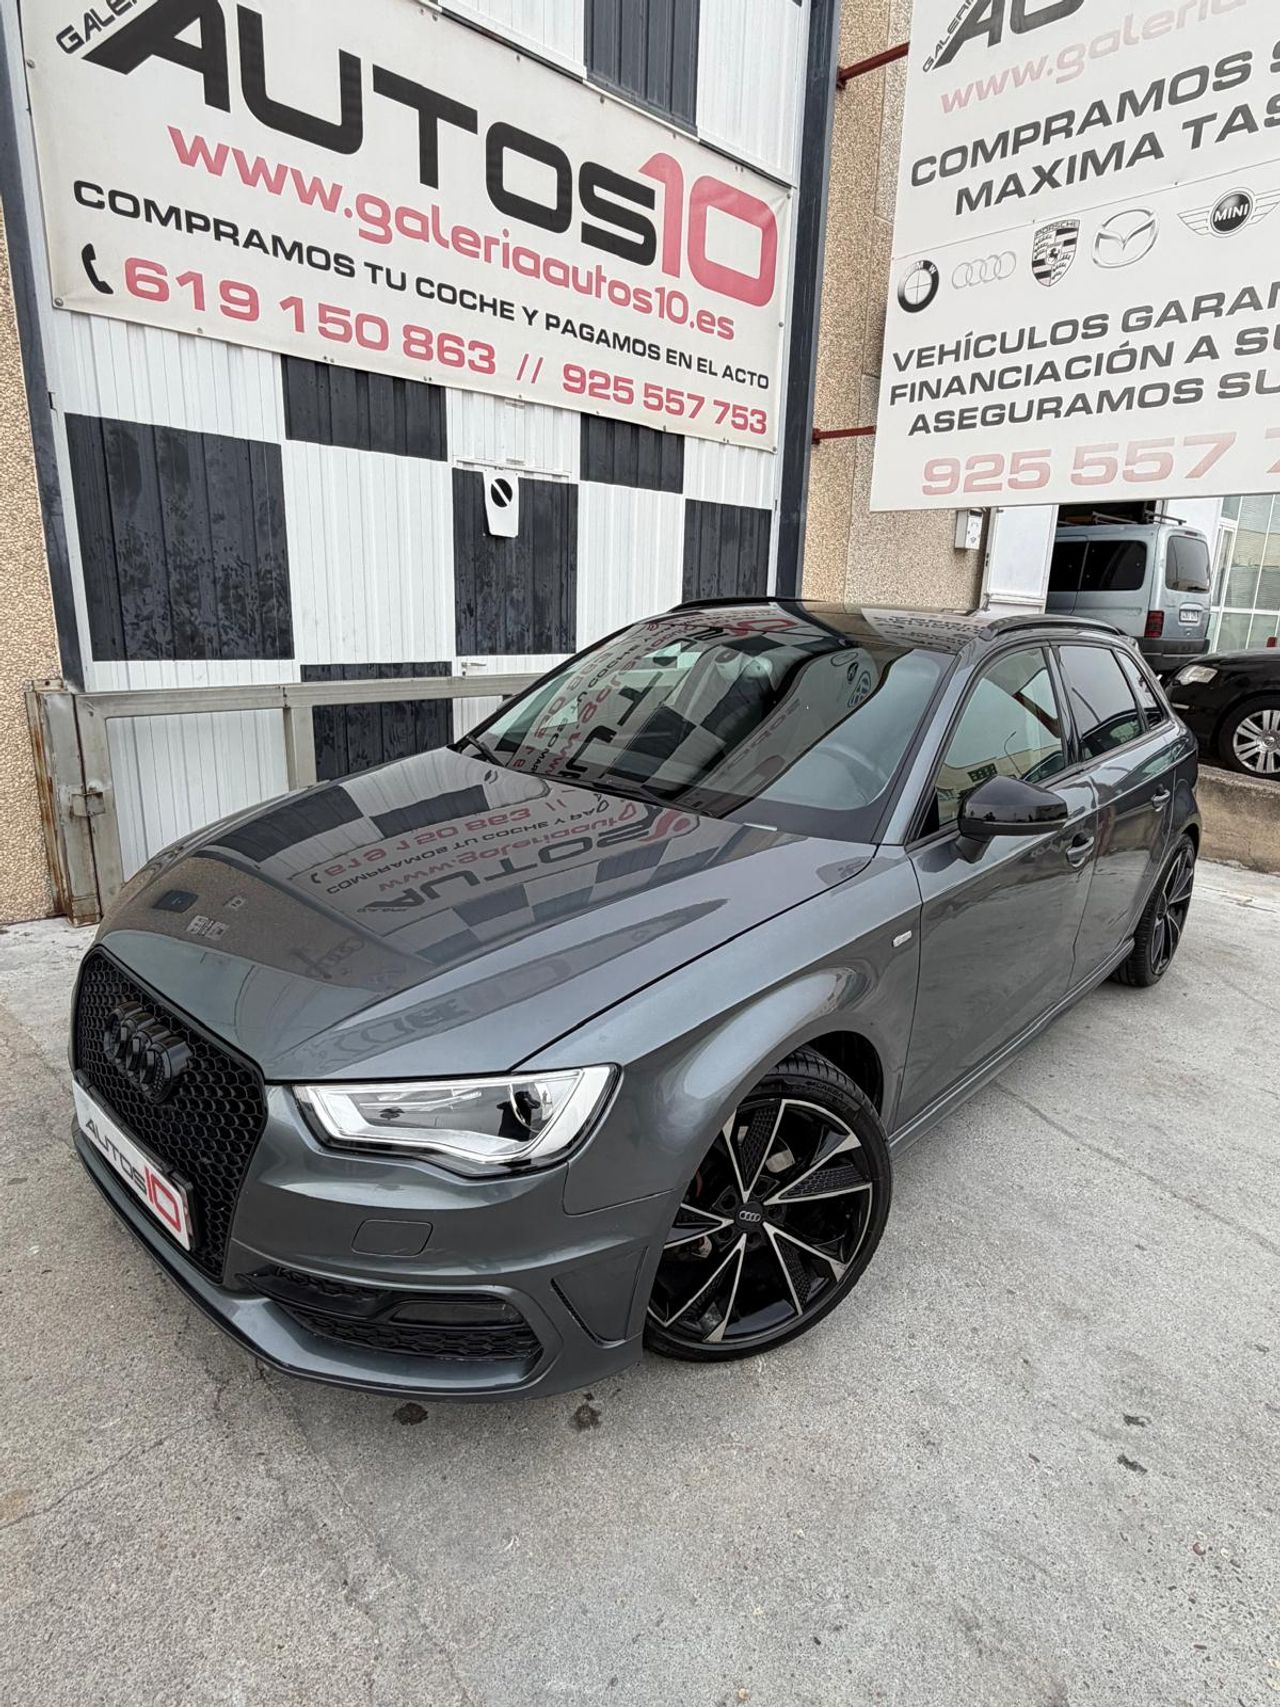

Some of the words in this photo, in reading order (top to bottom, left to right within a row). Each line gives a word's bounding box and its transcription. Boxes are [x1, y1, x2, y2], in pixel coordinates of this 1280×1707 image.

[56, 0, 137, 54] GALE
[923, 0, 974, 72] GALER
[81, 0, 778, 307] AUTOS10
[911, 51, 1253, 187] COMPRAMOS
[955, 132, 1164, 216] MAXIMA
[1213, 203, 1249, 223] MINI
[167, 125, 735, 342] www.galeriaautos10.es
[73, 180, 356, 279] COMPRAMOS
[364, 262, 407, 291] TU
[415, 277, 515, 321] COCHE
[522, 305, 539, 327] Y
[545, 313, 661, 361] PAGAMOS
[666, 348, 693, 371] EN
[697, 357, 719, 378] EL
[721, 365, 770, 390] ACTO
[124, 257, 260, 322] 619
[279, 296, 390, 353] 150
[402, 324, 497, 375] 863
[562, 363, 635, 406] 925
[642, 384, 705, 420] 557
[713, 400, 768, 435] 753
[889, 341, 1175, 406] FINANCIACIÓN
[1184, 335, 1220, 364] A
[1234, 326, 1280, 356] S
[892, 313, 1110, 373] VEHÍCULOS
[908, 378, 1204, 436] ASEGURAMOS
[921, 449, 1052, 496] 925
[1070, 432, 1237, 487] 557
[85, 1118, 182, 1233] AUTOS10
